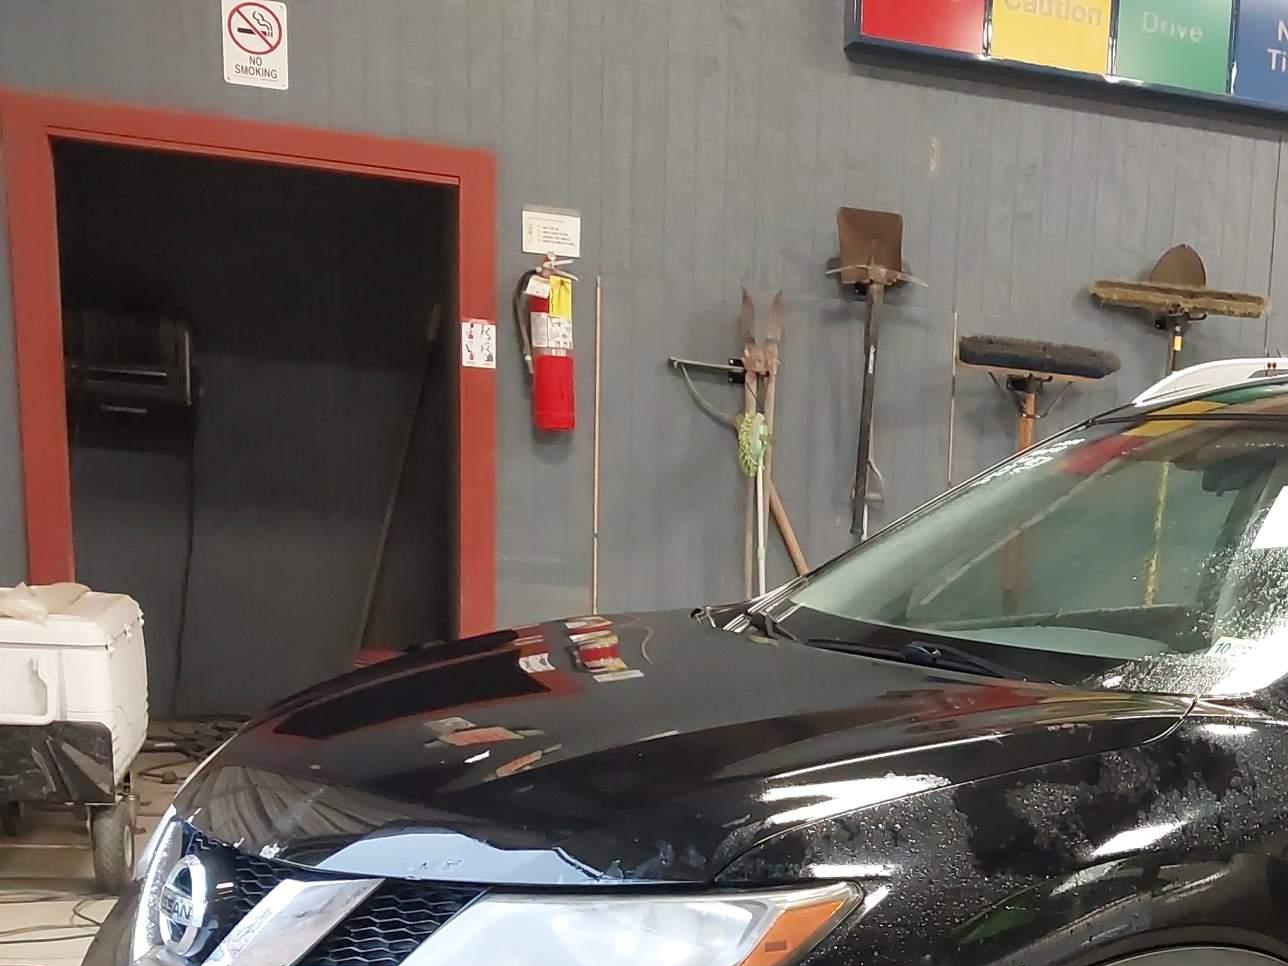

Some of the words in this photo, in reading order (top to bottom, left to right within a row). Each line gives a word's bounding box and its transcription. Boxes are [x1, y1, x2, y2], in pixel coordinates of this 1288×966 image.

[1143, 11, 1202, 42] Drive
[249, 55, 262, 66] NO
[234, 64, 277, 78] SMOKING
